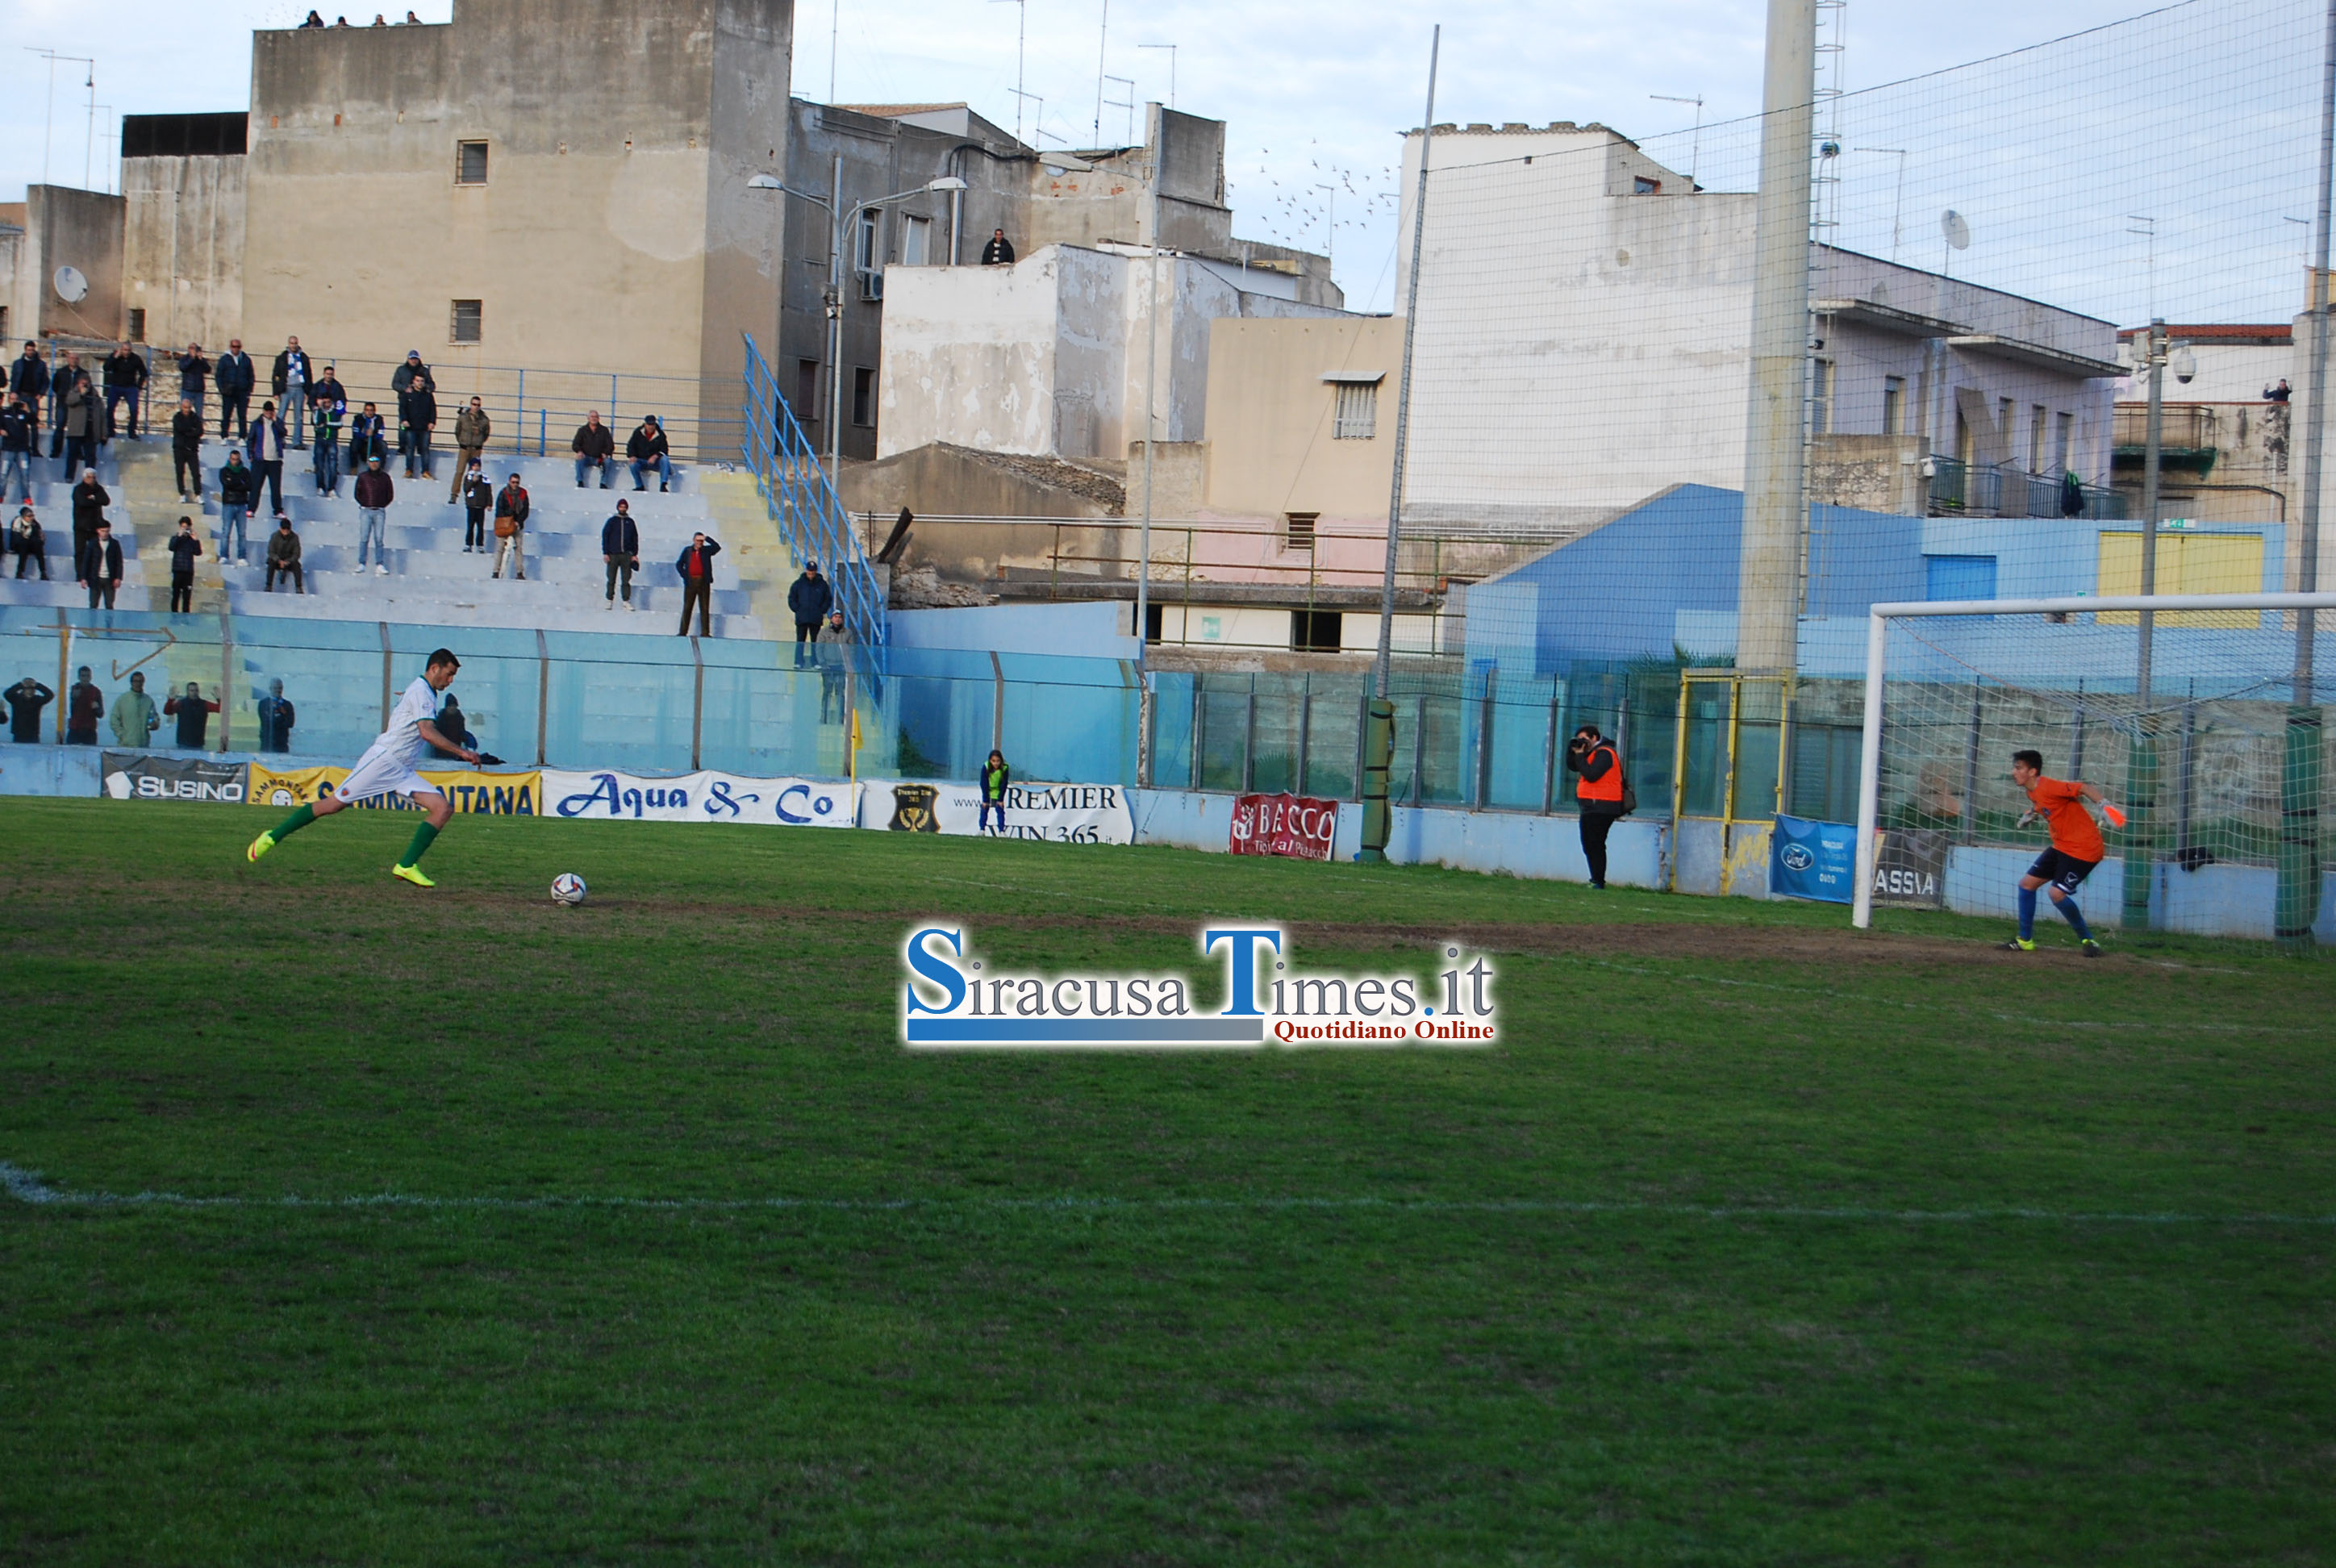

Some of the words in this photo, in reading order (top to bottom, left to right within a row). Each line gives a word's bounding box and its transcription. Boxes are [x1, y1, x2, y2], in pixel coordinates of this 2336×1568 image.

[138, 776, 243, 801] SUSINO
[557, 774, 688, 818] Aqua
[704, 782, 760, 817] &
[775, 784, 833, 824] Co
[1007, 787, 1117, 810] REMIER
[1259, 803, 1334, 840] BACCO
